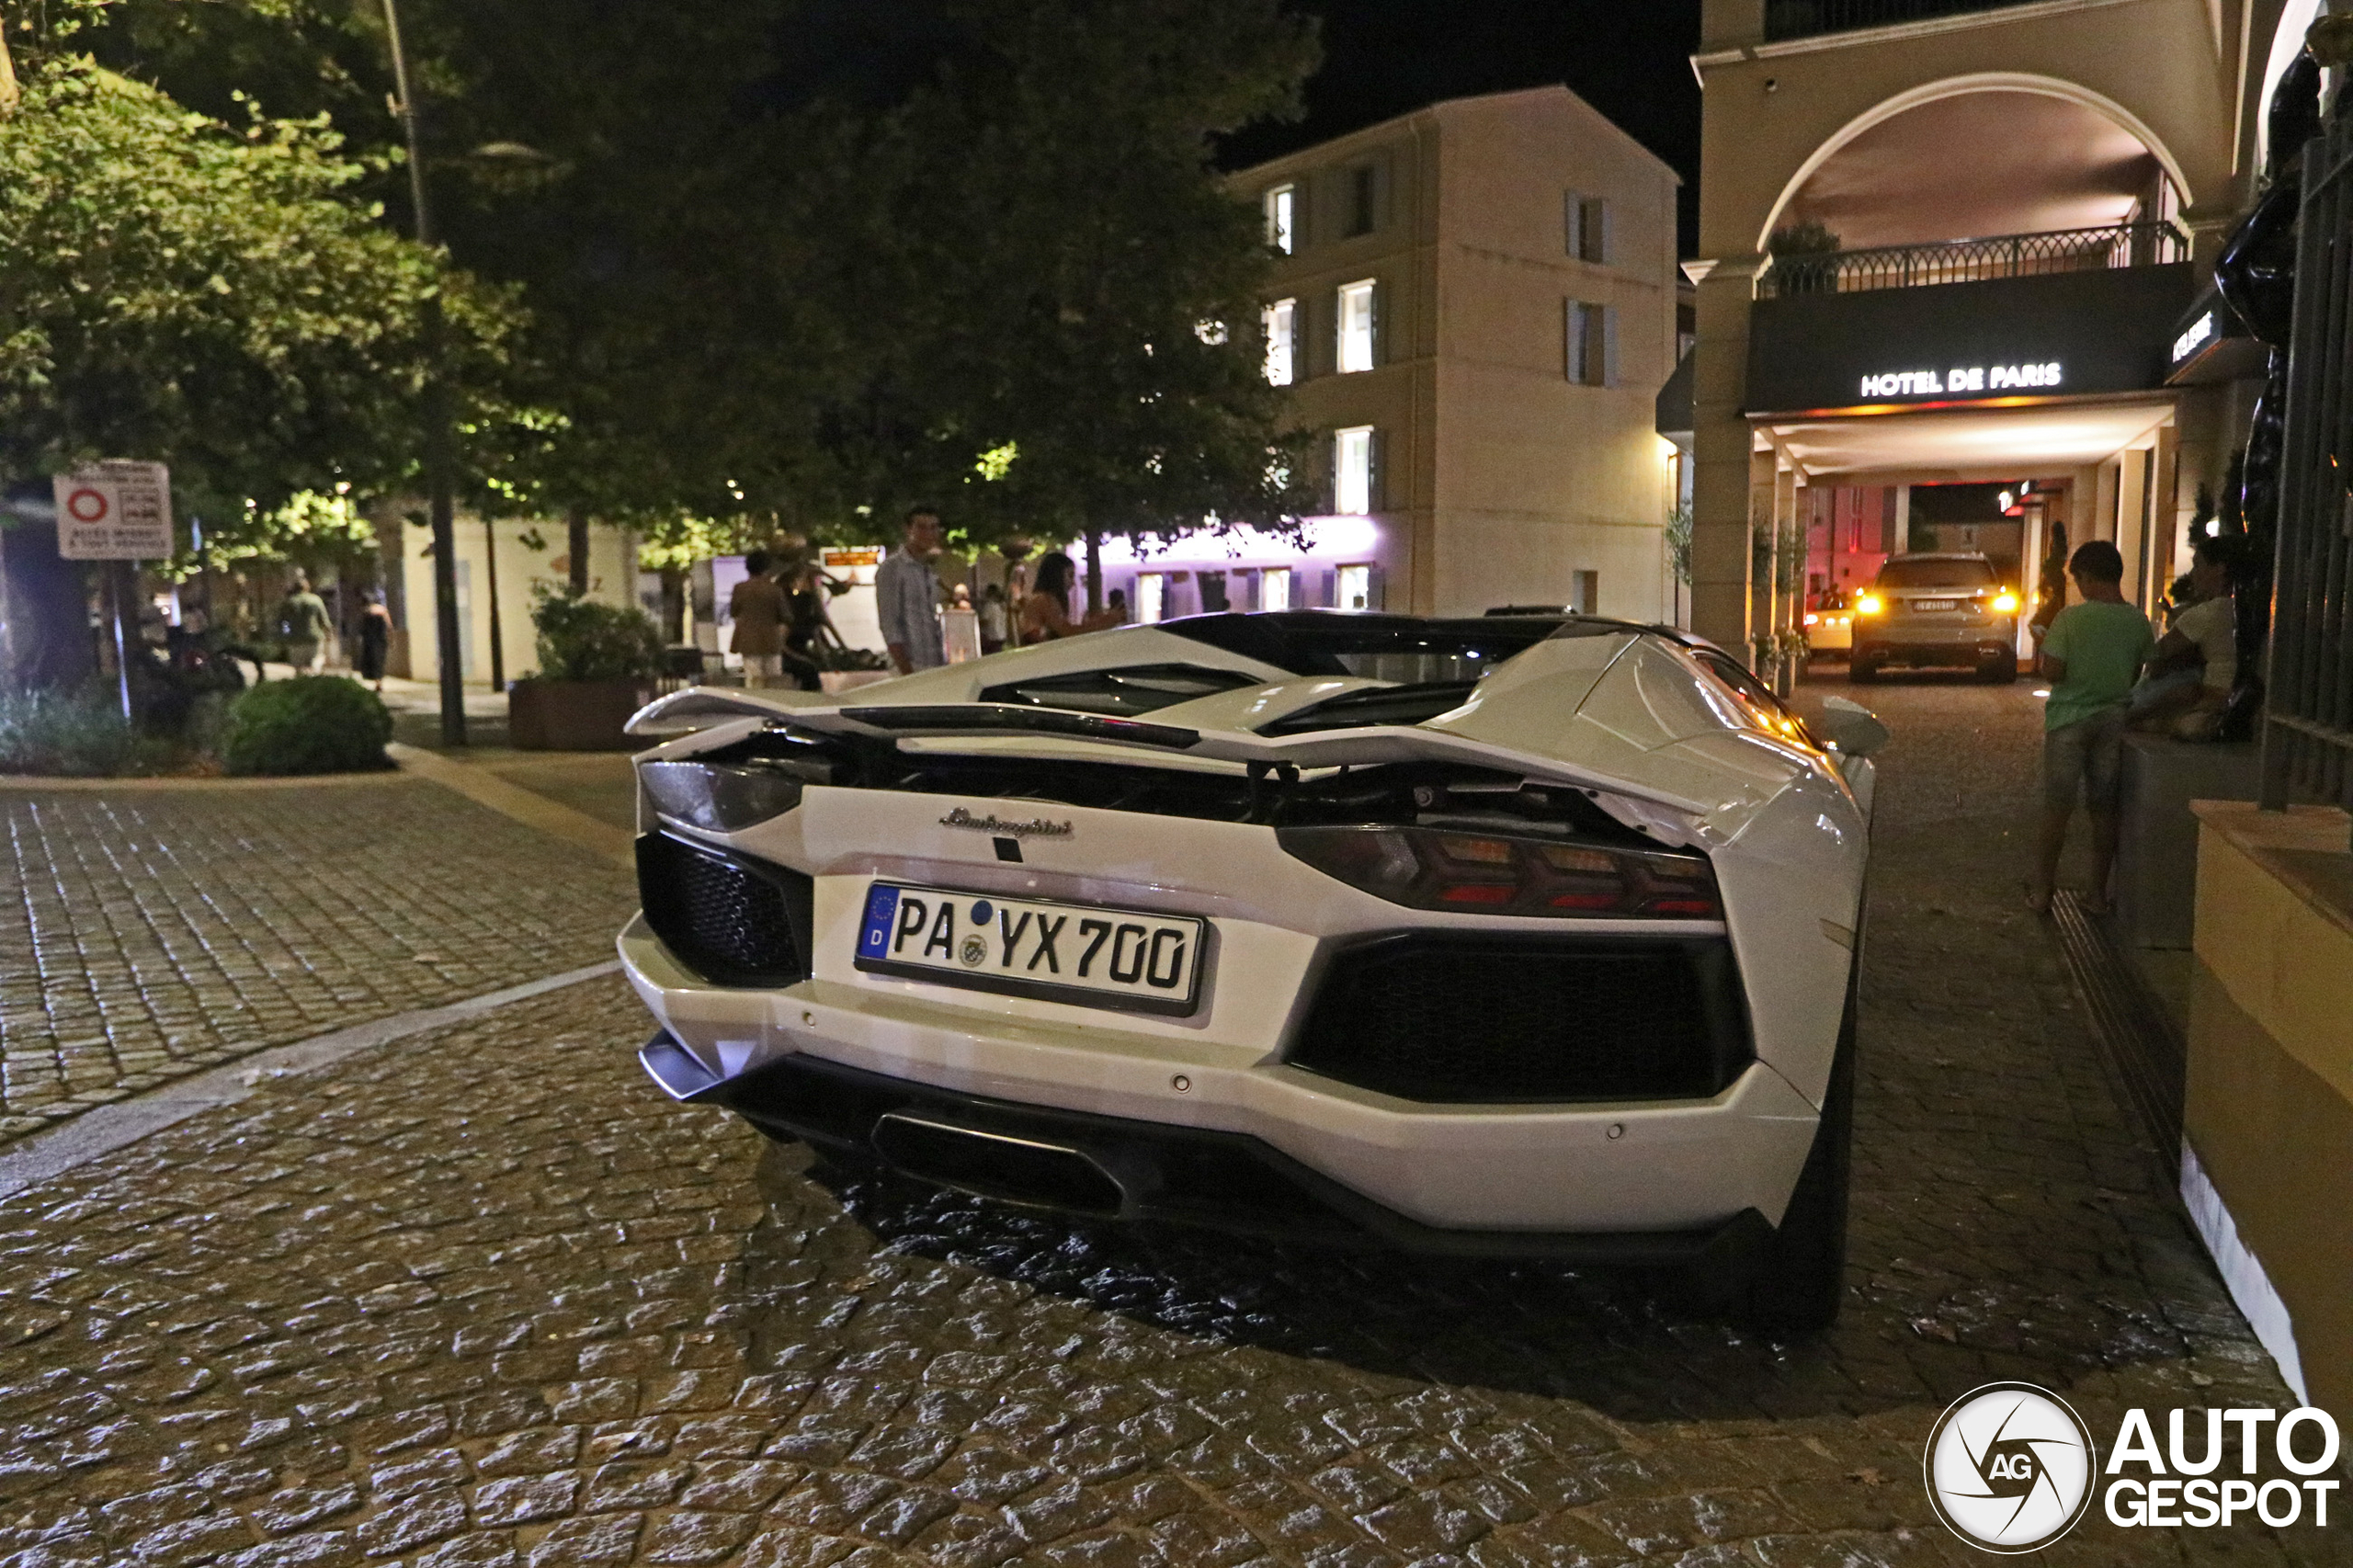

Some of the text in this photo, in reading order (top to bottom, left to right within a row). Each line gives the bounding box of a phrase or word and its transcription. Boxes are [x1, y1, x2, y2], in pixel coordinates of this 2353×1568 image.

[1860, 362, 2062, 397] HOTEL DE PARIS
[870, 930, 882, 946] D
[892, 898, 1186, 989] PA YX 700
